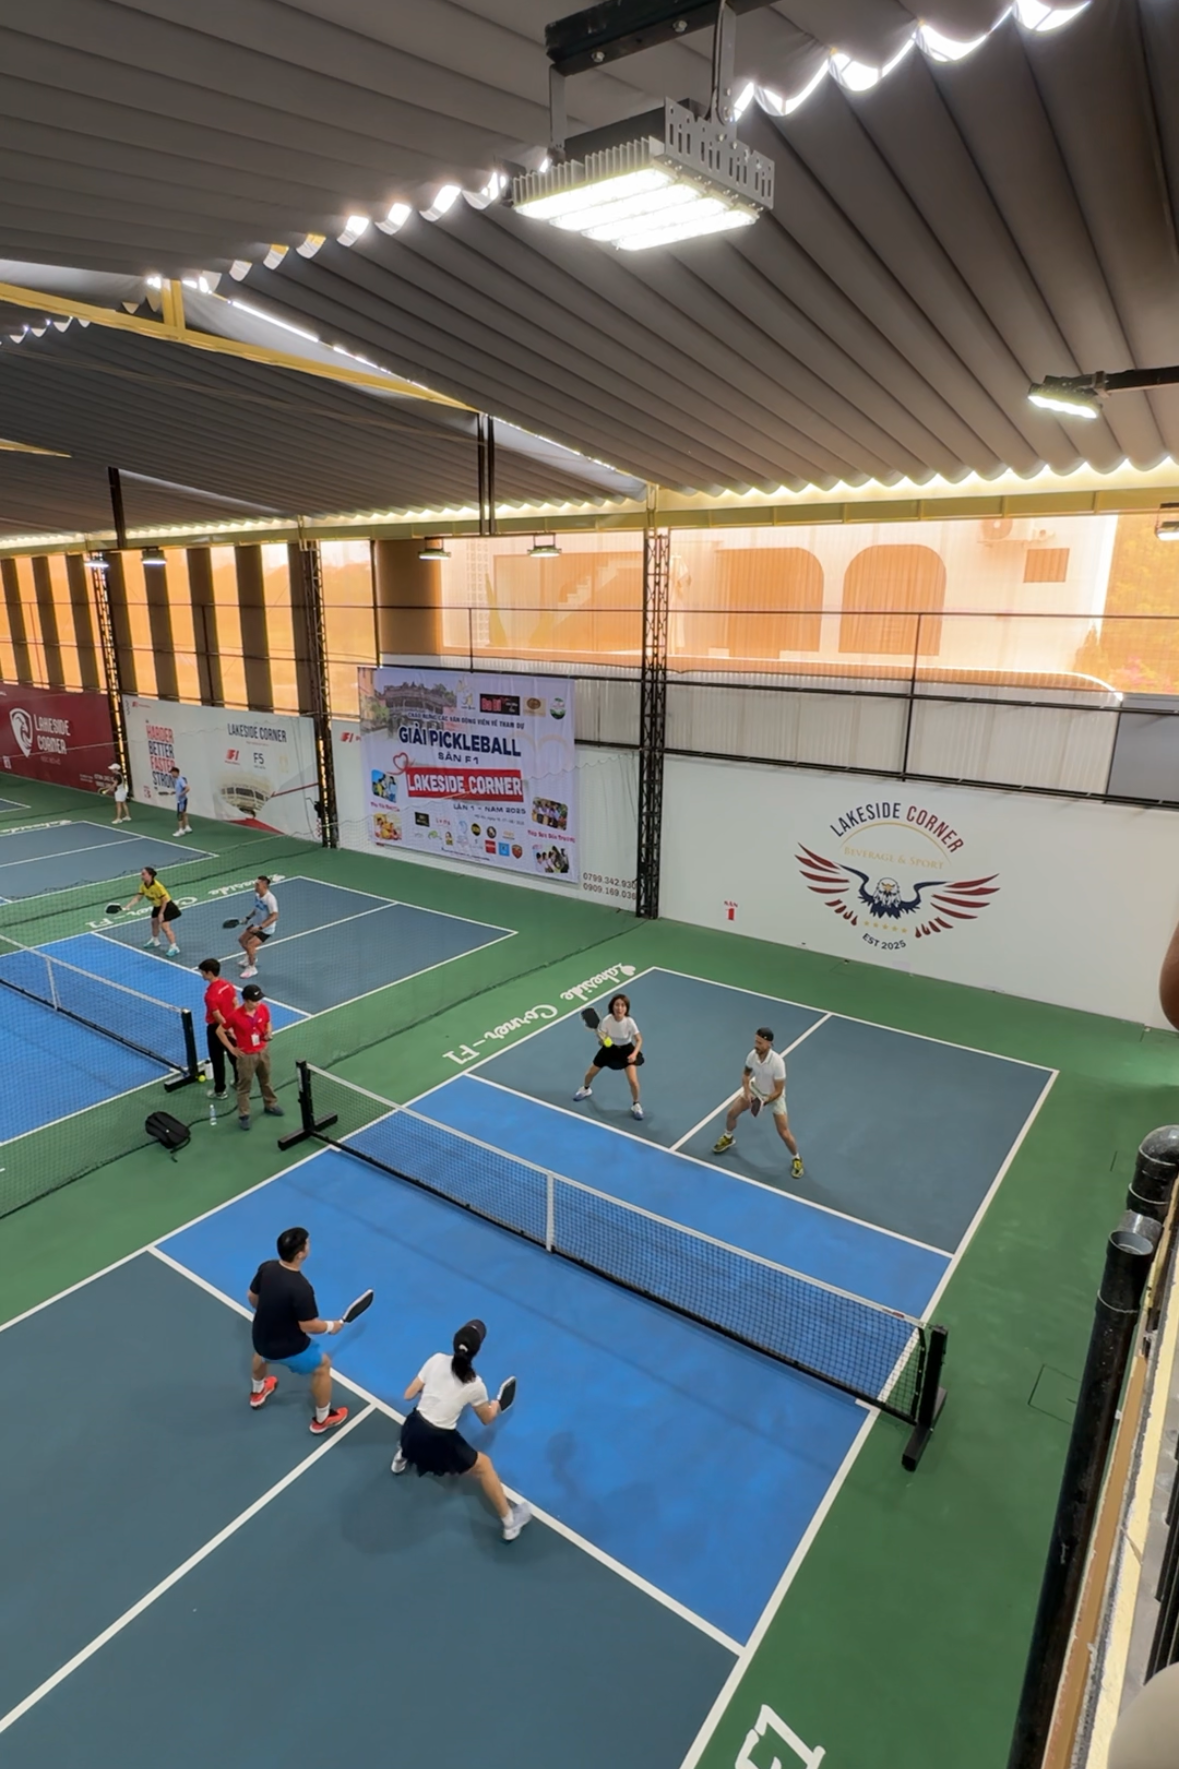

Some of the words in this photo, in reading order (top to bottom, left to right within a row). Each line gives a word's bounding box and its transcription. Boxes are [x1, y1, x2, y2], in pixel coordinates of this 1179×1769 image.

[227, 723, 258, 739] LAKESIDE
[259, 727, 287, 743] CORNER
[399, 723, 427, 745] GIẢI
[429, 728, 521, 757] PICKLEBALL
[148, 740, 175, 759] BETTER
[253, 752, 265, 765] F5
[438, 751, 462, 763] SÂN
[465, 755, 479, 765] F1
[407, 774, 466, 794] LAKESIDE
[468, 775, 523, 796] CORNER
[505, 807, 526, 815] 2025
[830, 802, 901, 837] LAKESIDE
[906, 805, 964, 853] CORNER
[844, 846, 894, 863] BEVERAGE
[897, 855, 906, 865] &
[910, 855, 945, 871] SPORT
[862, 932, 880, 947] EST
[881, 939, 907, 951] 2025
[560, 962, 627, 1002] Lakeside
